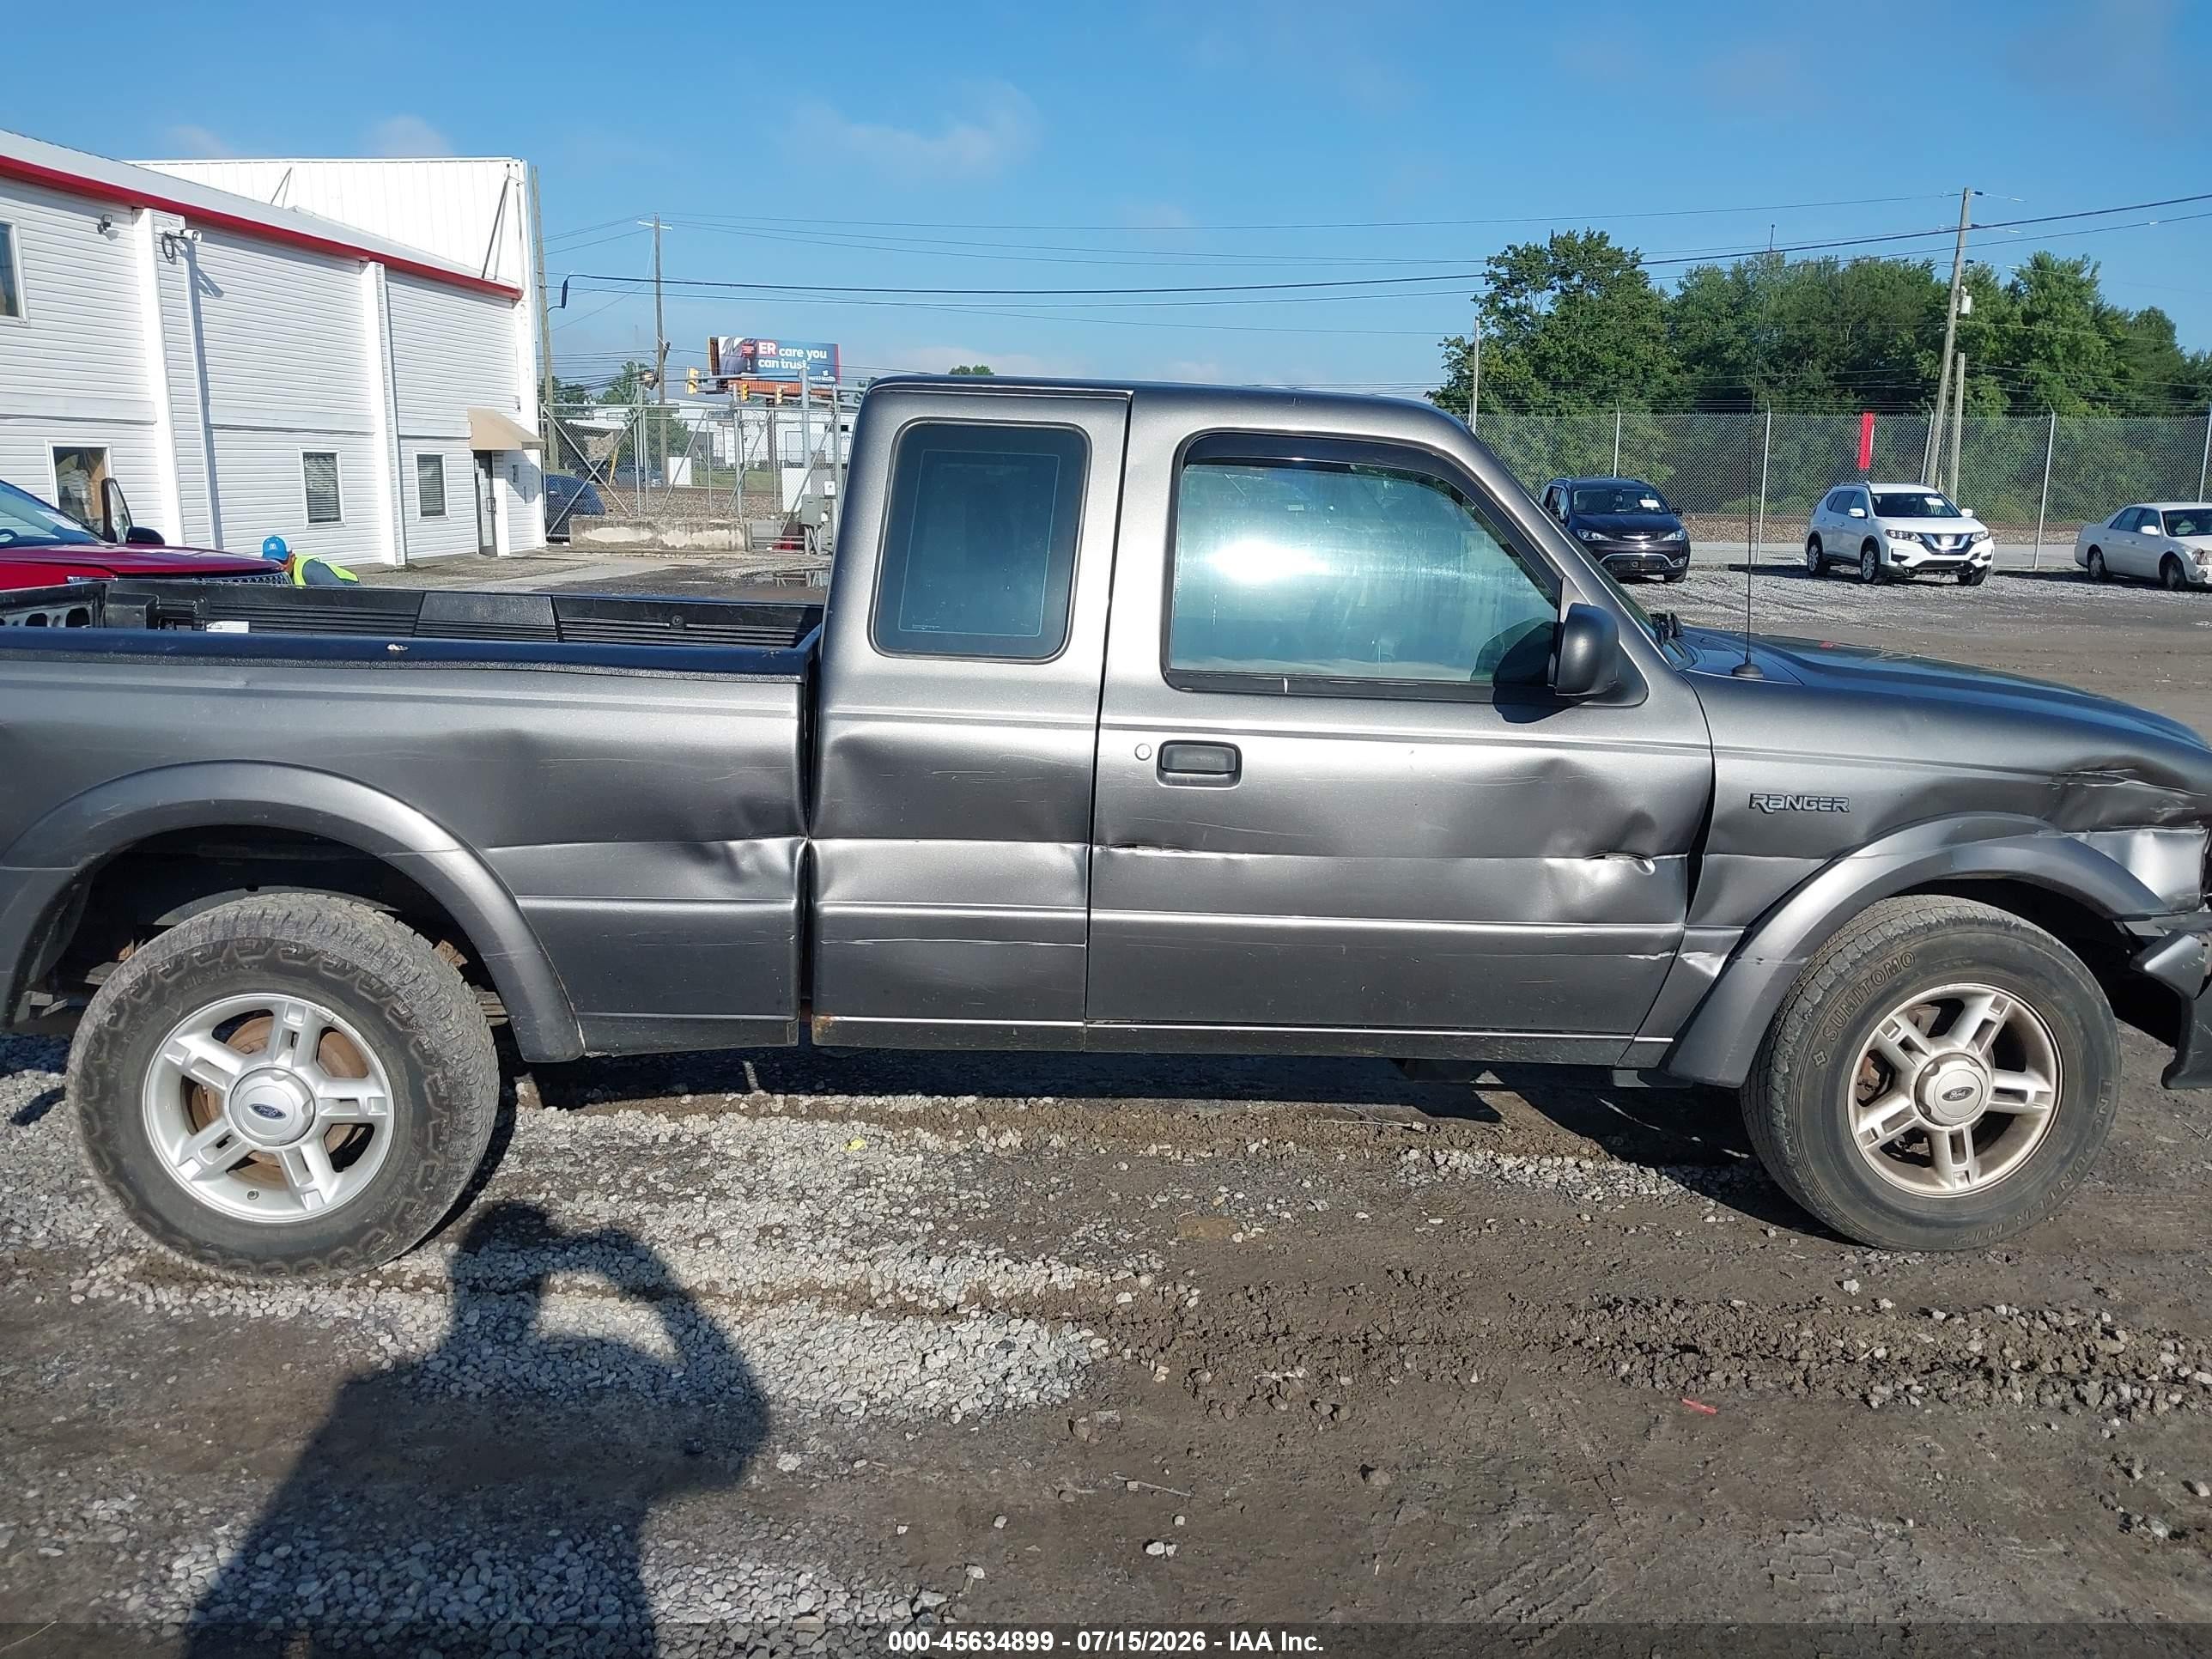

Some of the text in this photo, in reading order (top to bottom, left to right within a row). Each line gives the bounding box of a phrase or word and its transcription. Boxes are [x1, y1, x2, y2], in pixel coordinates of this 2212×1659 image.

[758, 342, 777, 356] ER
[779, 348, 805, 358] care
[806, 349, 828, 361] you
[757, 358, 811, 370] can trust.
[1748, 793, 1850, 814] RANGER
[1822, 951, 1917, 1042] SUMITOMO
